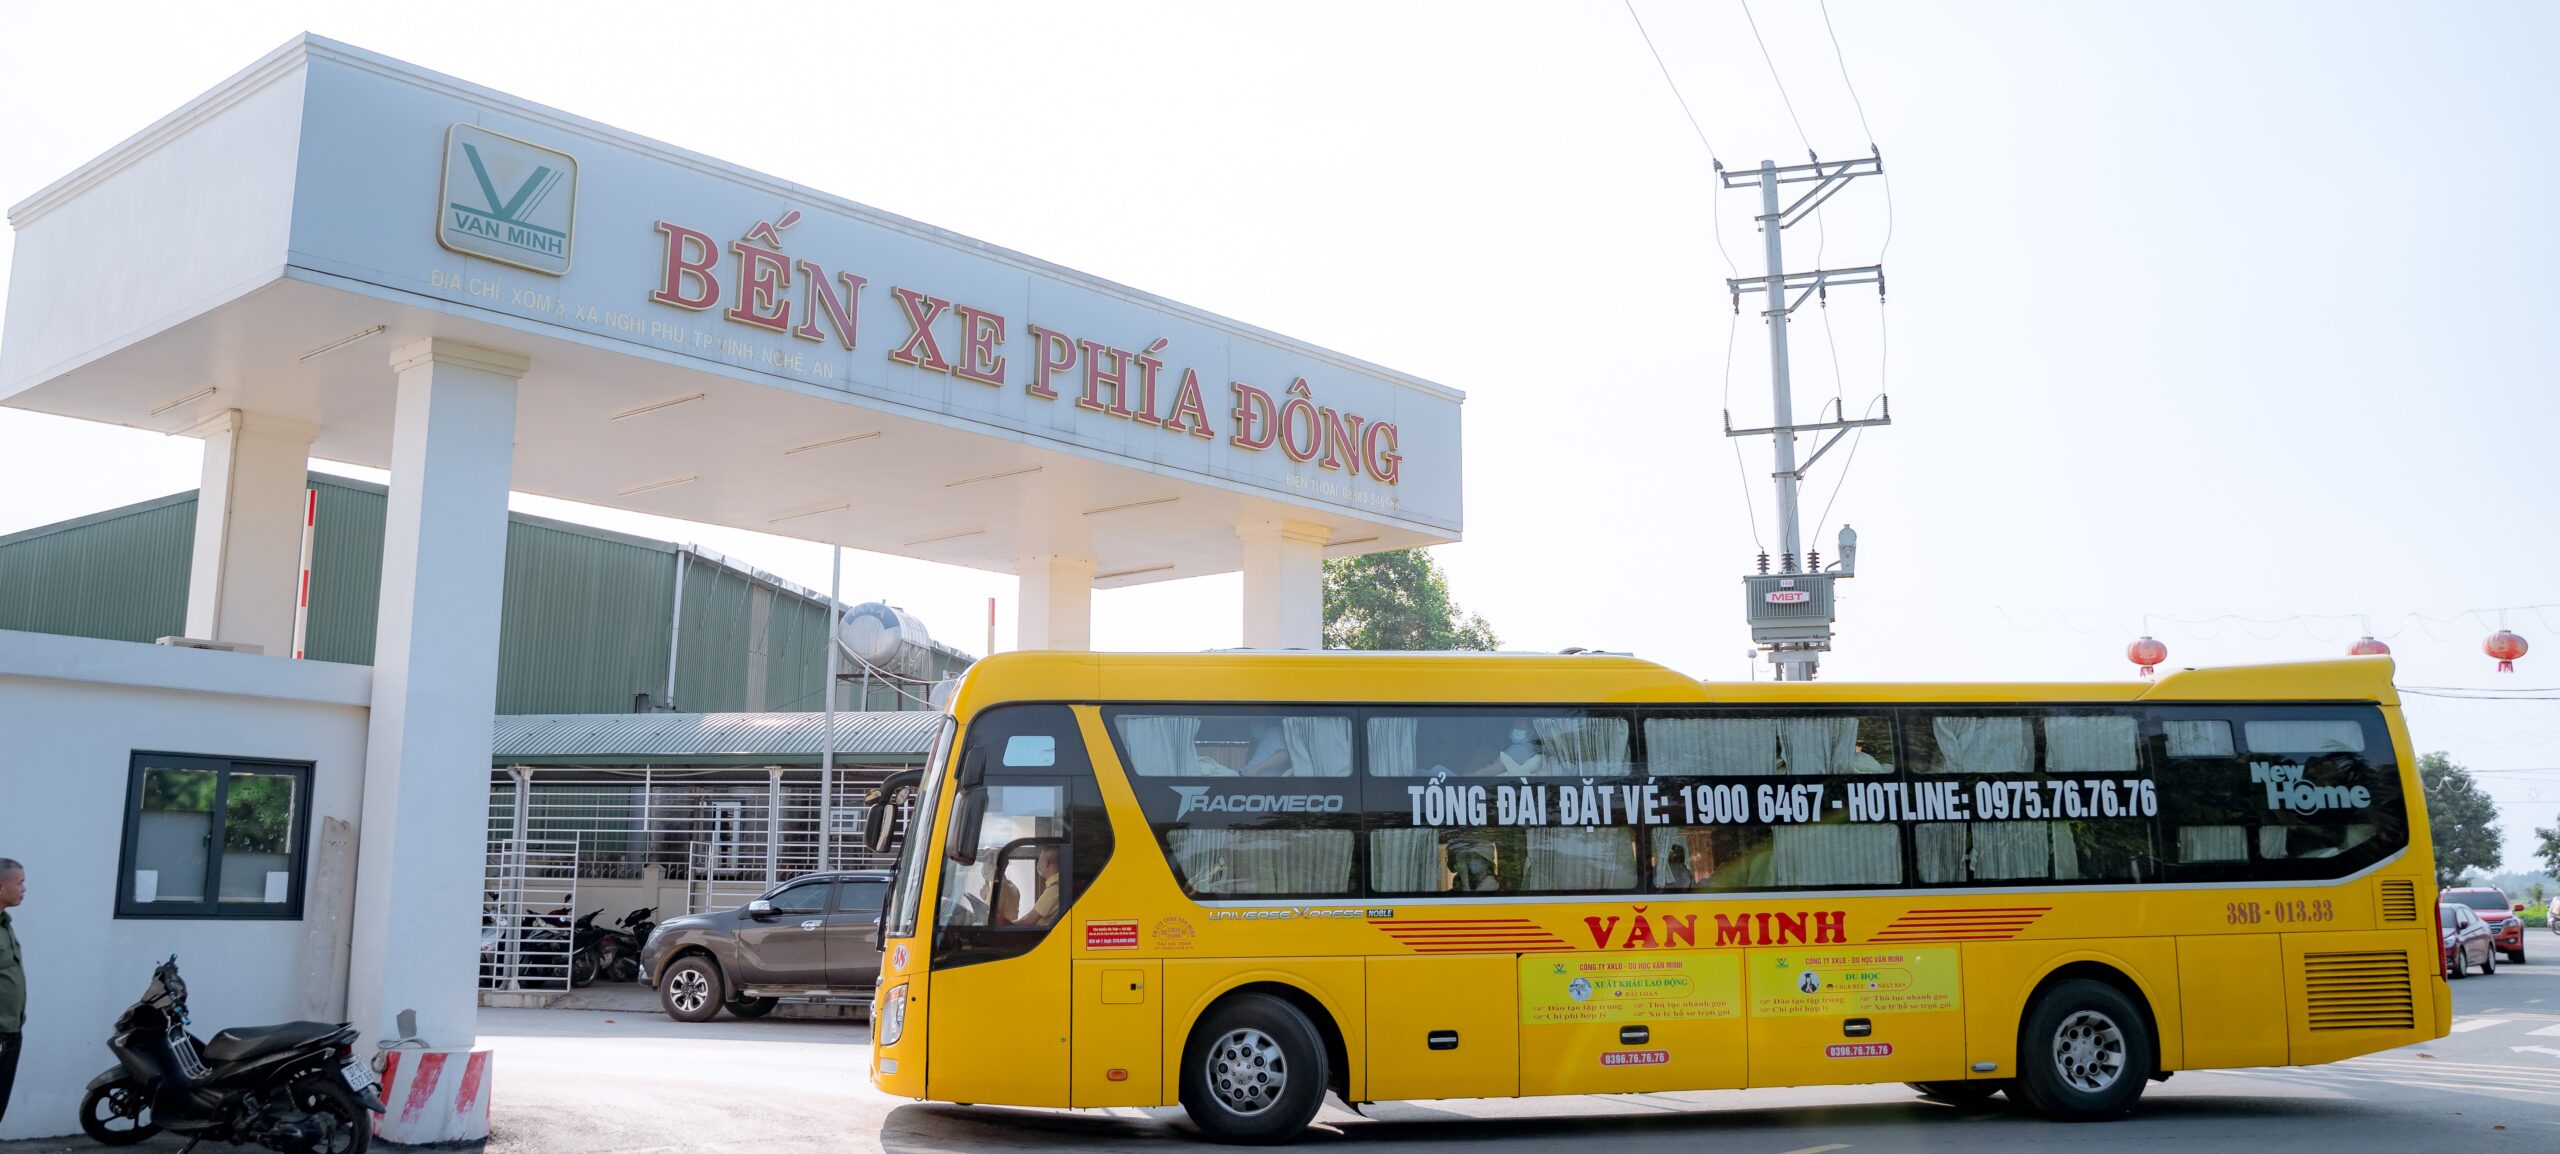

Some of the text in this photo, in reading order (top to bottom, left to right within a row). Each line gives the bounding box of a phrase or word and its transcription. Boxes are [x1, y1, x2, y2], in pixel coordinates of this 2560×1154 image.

[455, 212, 562, 254] VAN MINH
[431, 268, 462, 293] ĐỊA
[604, 309, 645, 336] NGHI
[812, 360, 834, 379] AN
[649, 209, 1403, 485] BẾN XE PHÍA ĐÔNG
[1772, 592, 1803, 600] MBT
[2250, 762, 2305, 784] New
[1168, 786, 1344, 822] TRACOMECO
[1408, 771, 1487, 826] TỔNG
[1497, 777, 1547, 826] ĐÀI
[1559, 777, 1614, 832] ĐẶT
[1622, 776, 1670, 825] VÉ:
[1680, 784, 1750, 824] 1900
[1757, 784, 1824, 823] 6467
[1847, 782, 1970, 822] HOTLINE:
[1975, 778, 2158, 820] 0975.76.76.76
[2267, 779, 2372, 816] Home
[1368, 910, 1393, 918] NOBLE
[2226, 902, 2262, 925] 38B
[2274, 900, 2334, 924] 013.33
[1584, 905, 1847, 950] VĂN MINH
[1664, 978, 1687, 988] ĐỘNG
[1861, 972, 1881, 981] HỌC
[1605, 1053, 1664, 1064] 0396.76.76.76
[1830, 1045, 1888, 1056] 0396.76.76.76
